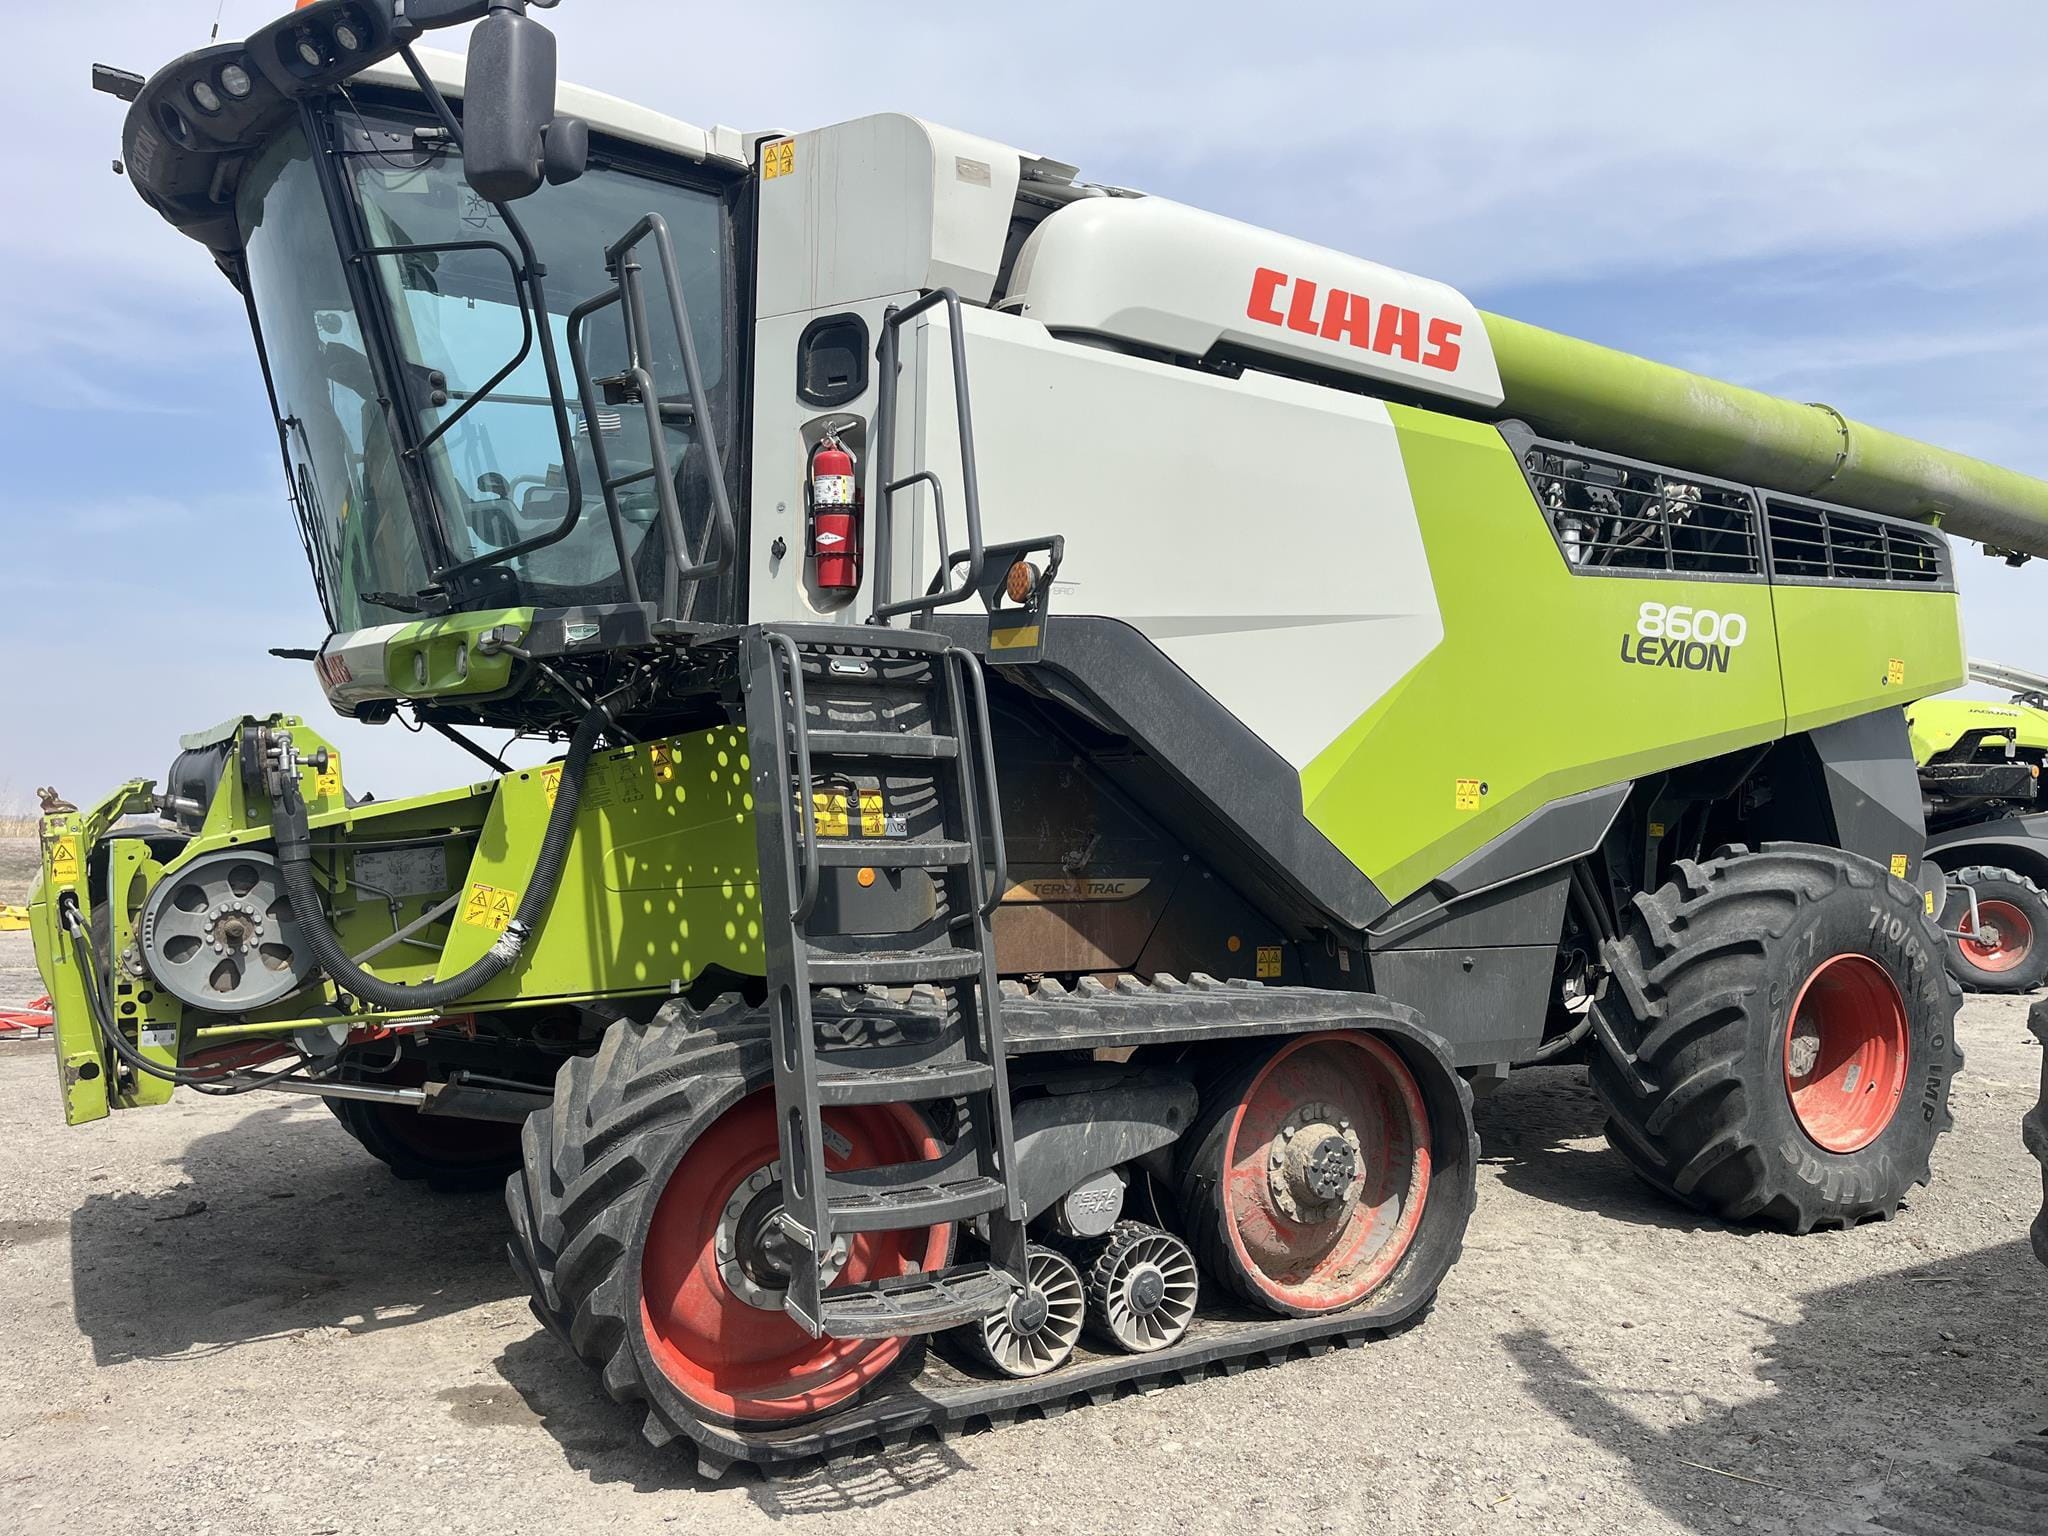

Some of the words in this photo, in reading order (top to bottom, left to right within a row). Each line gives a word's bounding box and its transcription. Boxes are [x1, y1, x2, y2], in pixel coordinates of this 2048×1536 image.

[1247, 267, 1462, 372] CLAAS
[1637, 601, 1748, 647] 8600
[1620, 633, 1731, 673] LEXION
[1968, 708, 2018, 718] JAGUAR
[1033, 883, 1082, 895] TERRA
[1087, 882, 1126, 894] TRAC
[1868, 906, 1929, 972] 710/65
[1073, 1187, 1118, 1205] TERRA
[1079, 1200, 1115, 1215] TRAC
